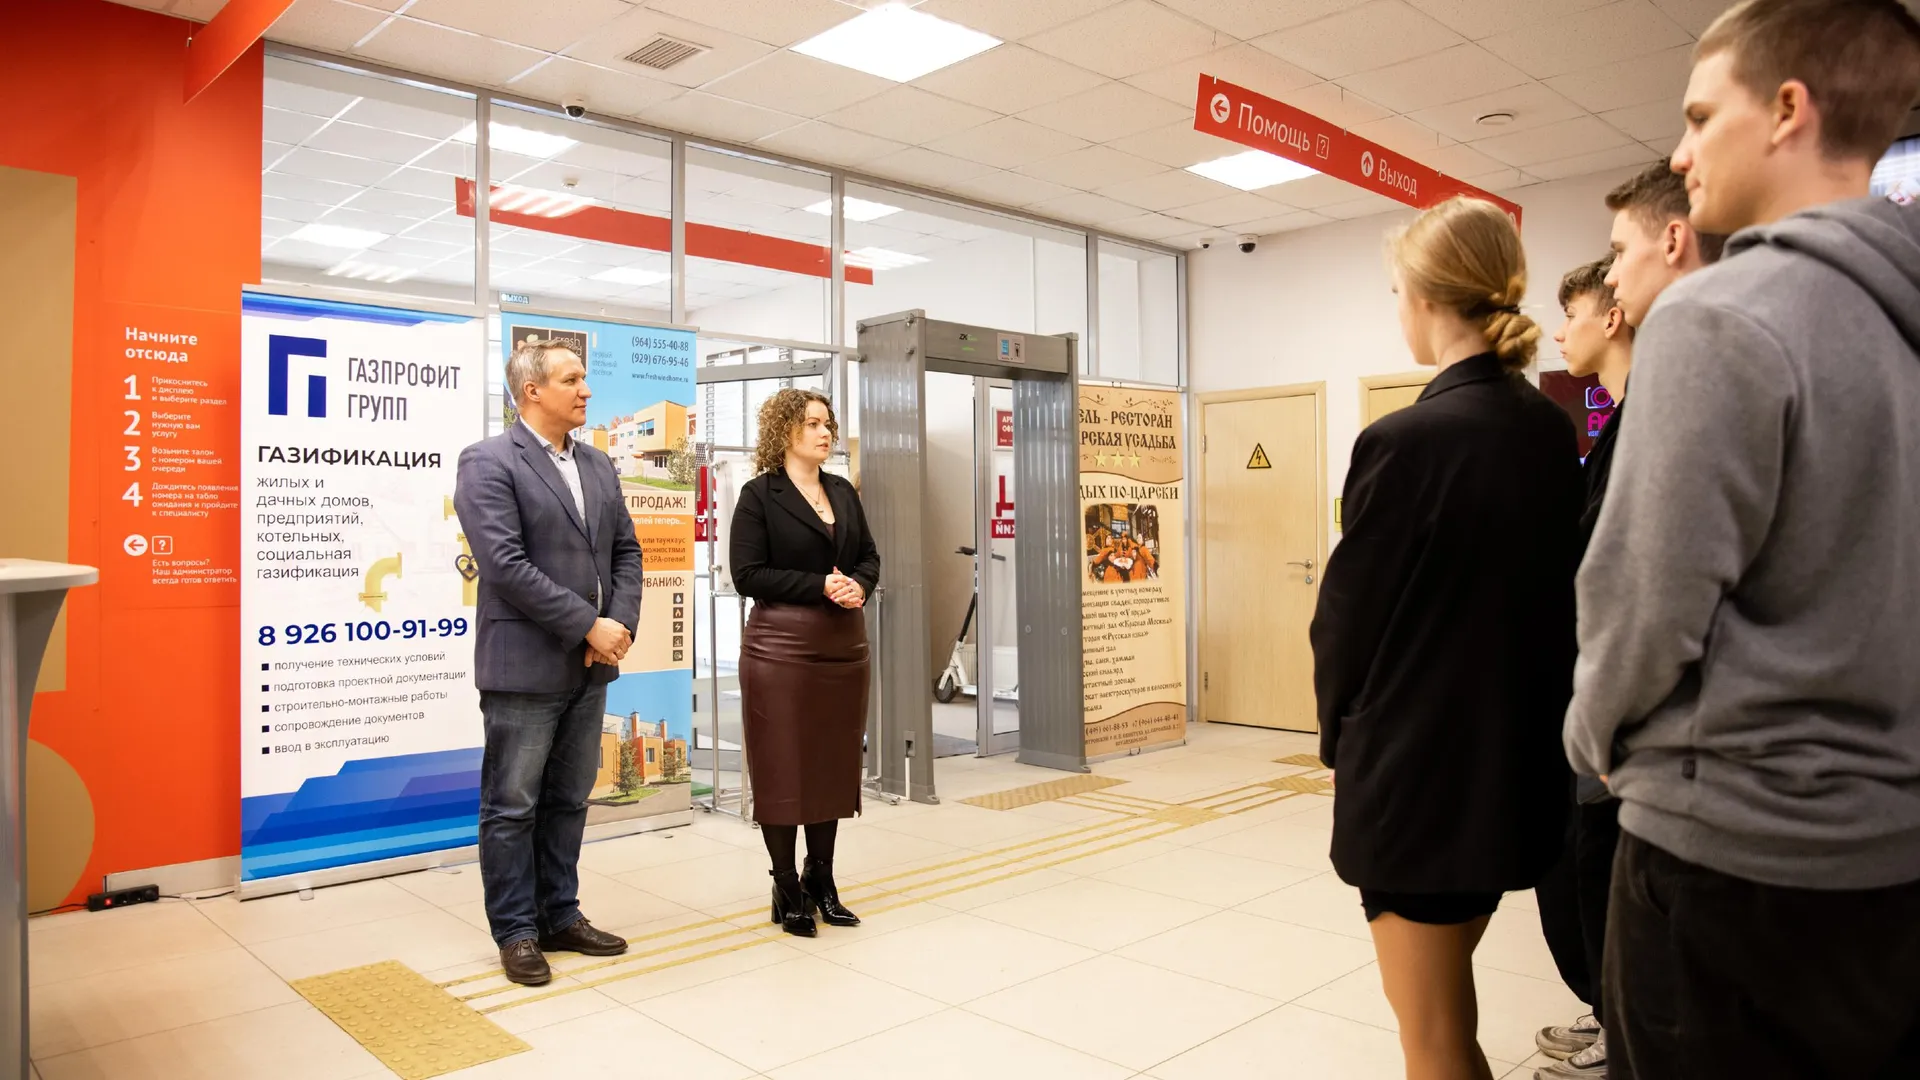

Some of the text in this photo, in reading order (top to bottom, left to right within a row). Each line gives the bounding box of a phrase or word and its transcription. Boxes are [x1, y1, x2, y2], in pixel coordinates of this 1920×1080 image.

[1238, 103, 1310, 153] Помощь
[1378, 158, 1417, 199] Выход
[502, 293, 528, 304] ыход
[125, 327, 198, 346] Начните
[632, 336, 689, 352] (964) 555-40-88
[125, 348, 188, 363] отсюда
[632, 352, 689, 368] (929) 676-95-46
[348, 357, 460, 390] ГАЗПРОФИТ
[124, 374, 141, 400] 1
[152, 376, 208, 387] Прикоснитесь
[159, 387, 194, 396] дисплею
[160, 396, 197, 405] выберите
[200, 398, 227, 406] раздел
[348, 393, 408, 422] ГРУПП
[124, 410, 141, 436] 2
[152, 412, 192, 420] Выберите
[1079, 408, 1100, 424] ЕЛЬ
[1111, 410, 1172, 428] РЕСТОРАН
[152, 422, 201, 431] нужную вам
[152, 430, 178, 440] услугу
[1081, 430, 1176, 450] РСКАЯ УСАДЬБА
[152, 447, 190, 456] Возьмите
[258, 445, 442, 470] ГАЗИФИКАЦИЯ
[124, 446, 141, 472] 3
[158, 457, 194, 466] номером
[197, 457, 222, 465] вашей
[152, 465, 186, 474] очереди
[152, 483, 238, 493] Дождитесь появления
[256, 476, 324, 489] жилых и
[122, 482, 143, 508] 4
[152, 492, 218, 500] номера на табло
[256, 494, 374, 508] дачных домов,
[1110, 486, 1178, 502] ПО-ЦАРСКИ
[152, 500, 192, 510] ожидания
[202, 500, 238, 510] пройдите
[632, 496, 686, 510] ПРОДАЖ!
[158, 509, 208, 518] специалисту
[257, 511, 364, 526] предприятий,
[633, 516, 652, 525] телей
[257, 531, 344, 544] котельных,
[656, 537, 686, 546] таунхаус
[256, 549, 352, 562] социальная
[152, 558, 210, 568] Есть вопросы?
[152, 568, 232, 578] Наш администратор
[257, 566, 360, 581] газификация
[152, 576, 238, 586] всегда готов ответить
[644, 576, 684, 588] ИВАНИЮ:
[1082, 590, 1108, 598] мещение
[258, 617, 468, 646] 8 926 100-91-99
[274, 652, 446, 672] получение технических условий
[274, 670, 466, 693] подготовка проектной документации
[274, 690, 448, 714] строительно-монтажные работы
[274, 710, 425, 733] сопровождение документов
[274, 734, 390, 754] ввод в эксплуатацию
